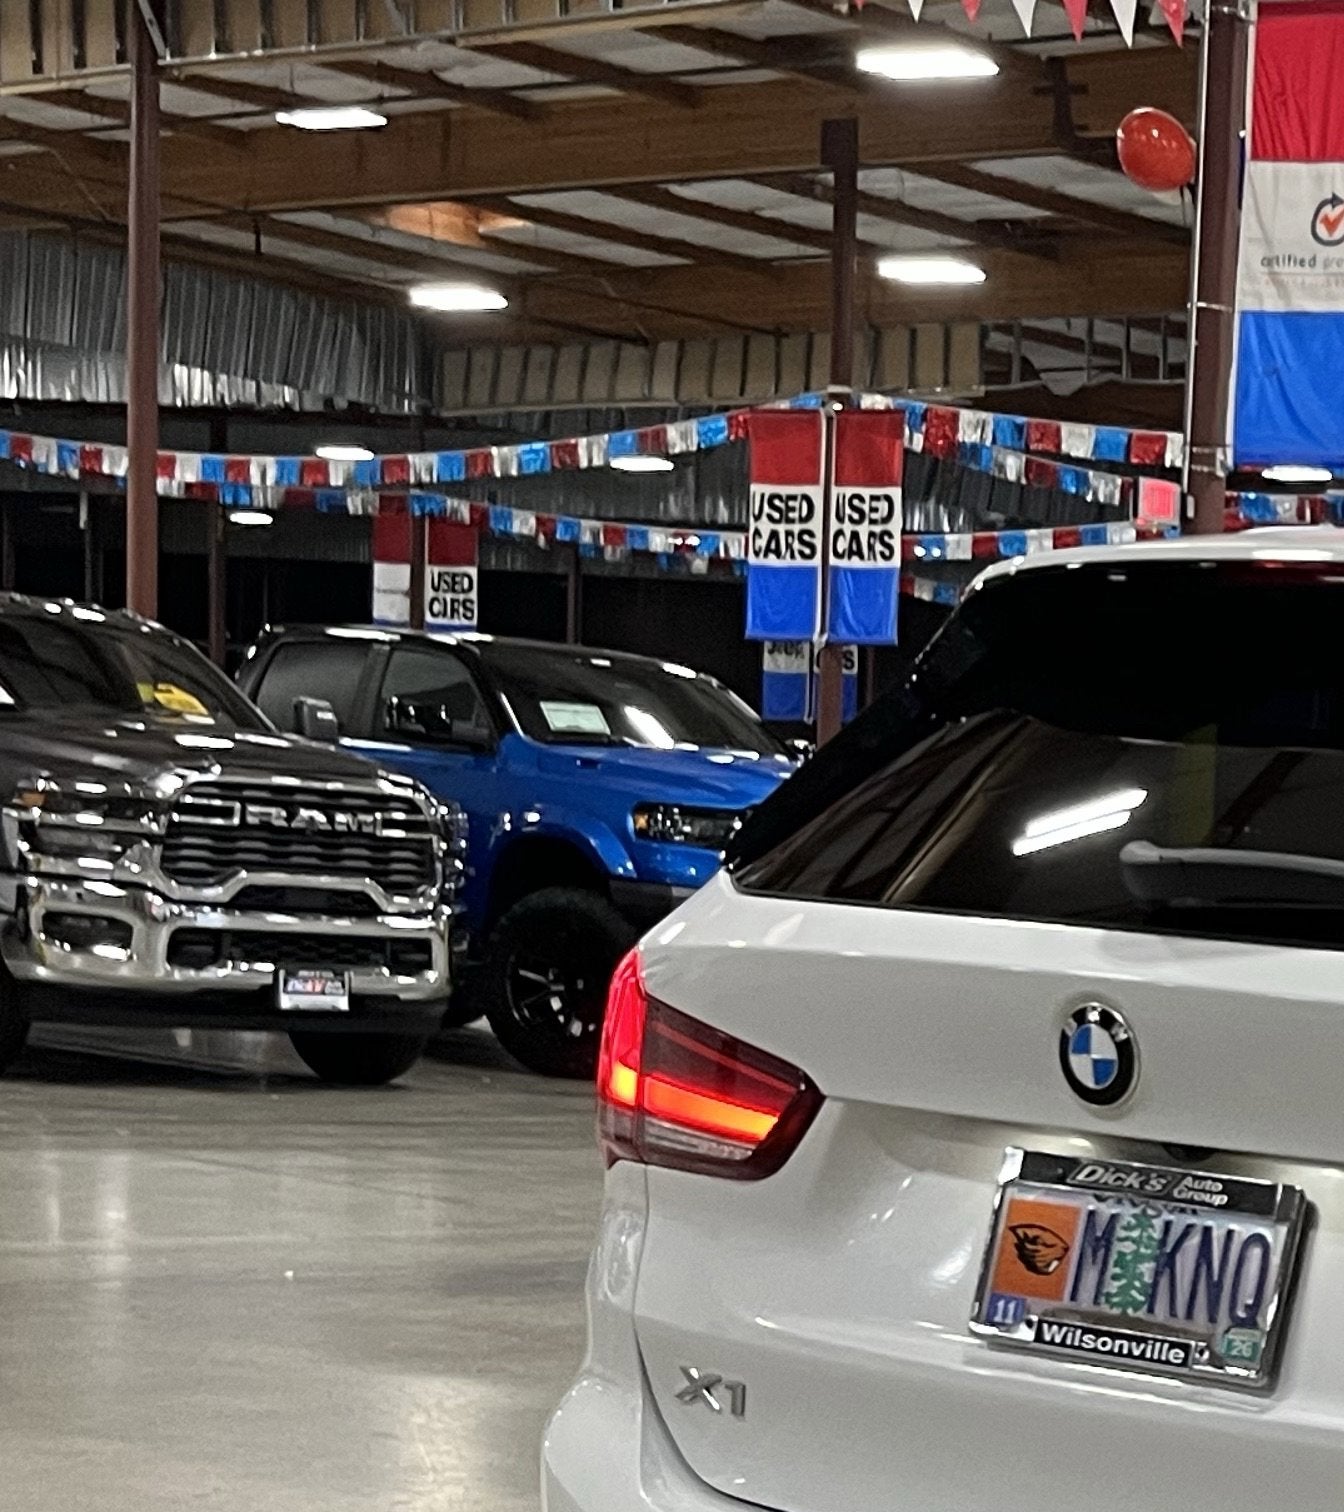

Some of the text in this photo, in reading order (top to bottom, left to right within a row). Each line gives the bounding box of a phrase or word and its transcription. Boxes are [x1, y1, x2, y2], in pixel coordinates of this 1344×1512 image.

[752, 492, 815, 524] USED
[835, 493, 895, 525] USED
[752, 527, 817, 560] CARS
[832, 528, 895, 561] CARS
[431, 570, 474, 594] USED
[245, 803, 375, 833] RAM
[1076, 1165, 1168, 1191] Dick's
[1178, 1176, 1223, 1192] Auto
[1173, 1187, 1228, 1206] Group
[995, 1299, 1018, 1323] 11
[1041, 1322, 1186, 1364] Wilsonville
[674, 1366, 746, 1420] X1
